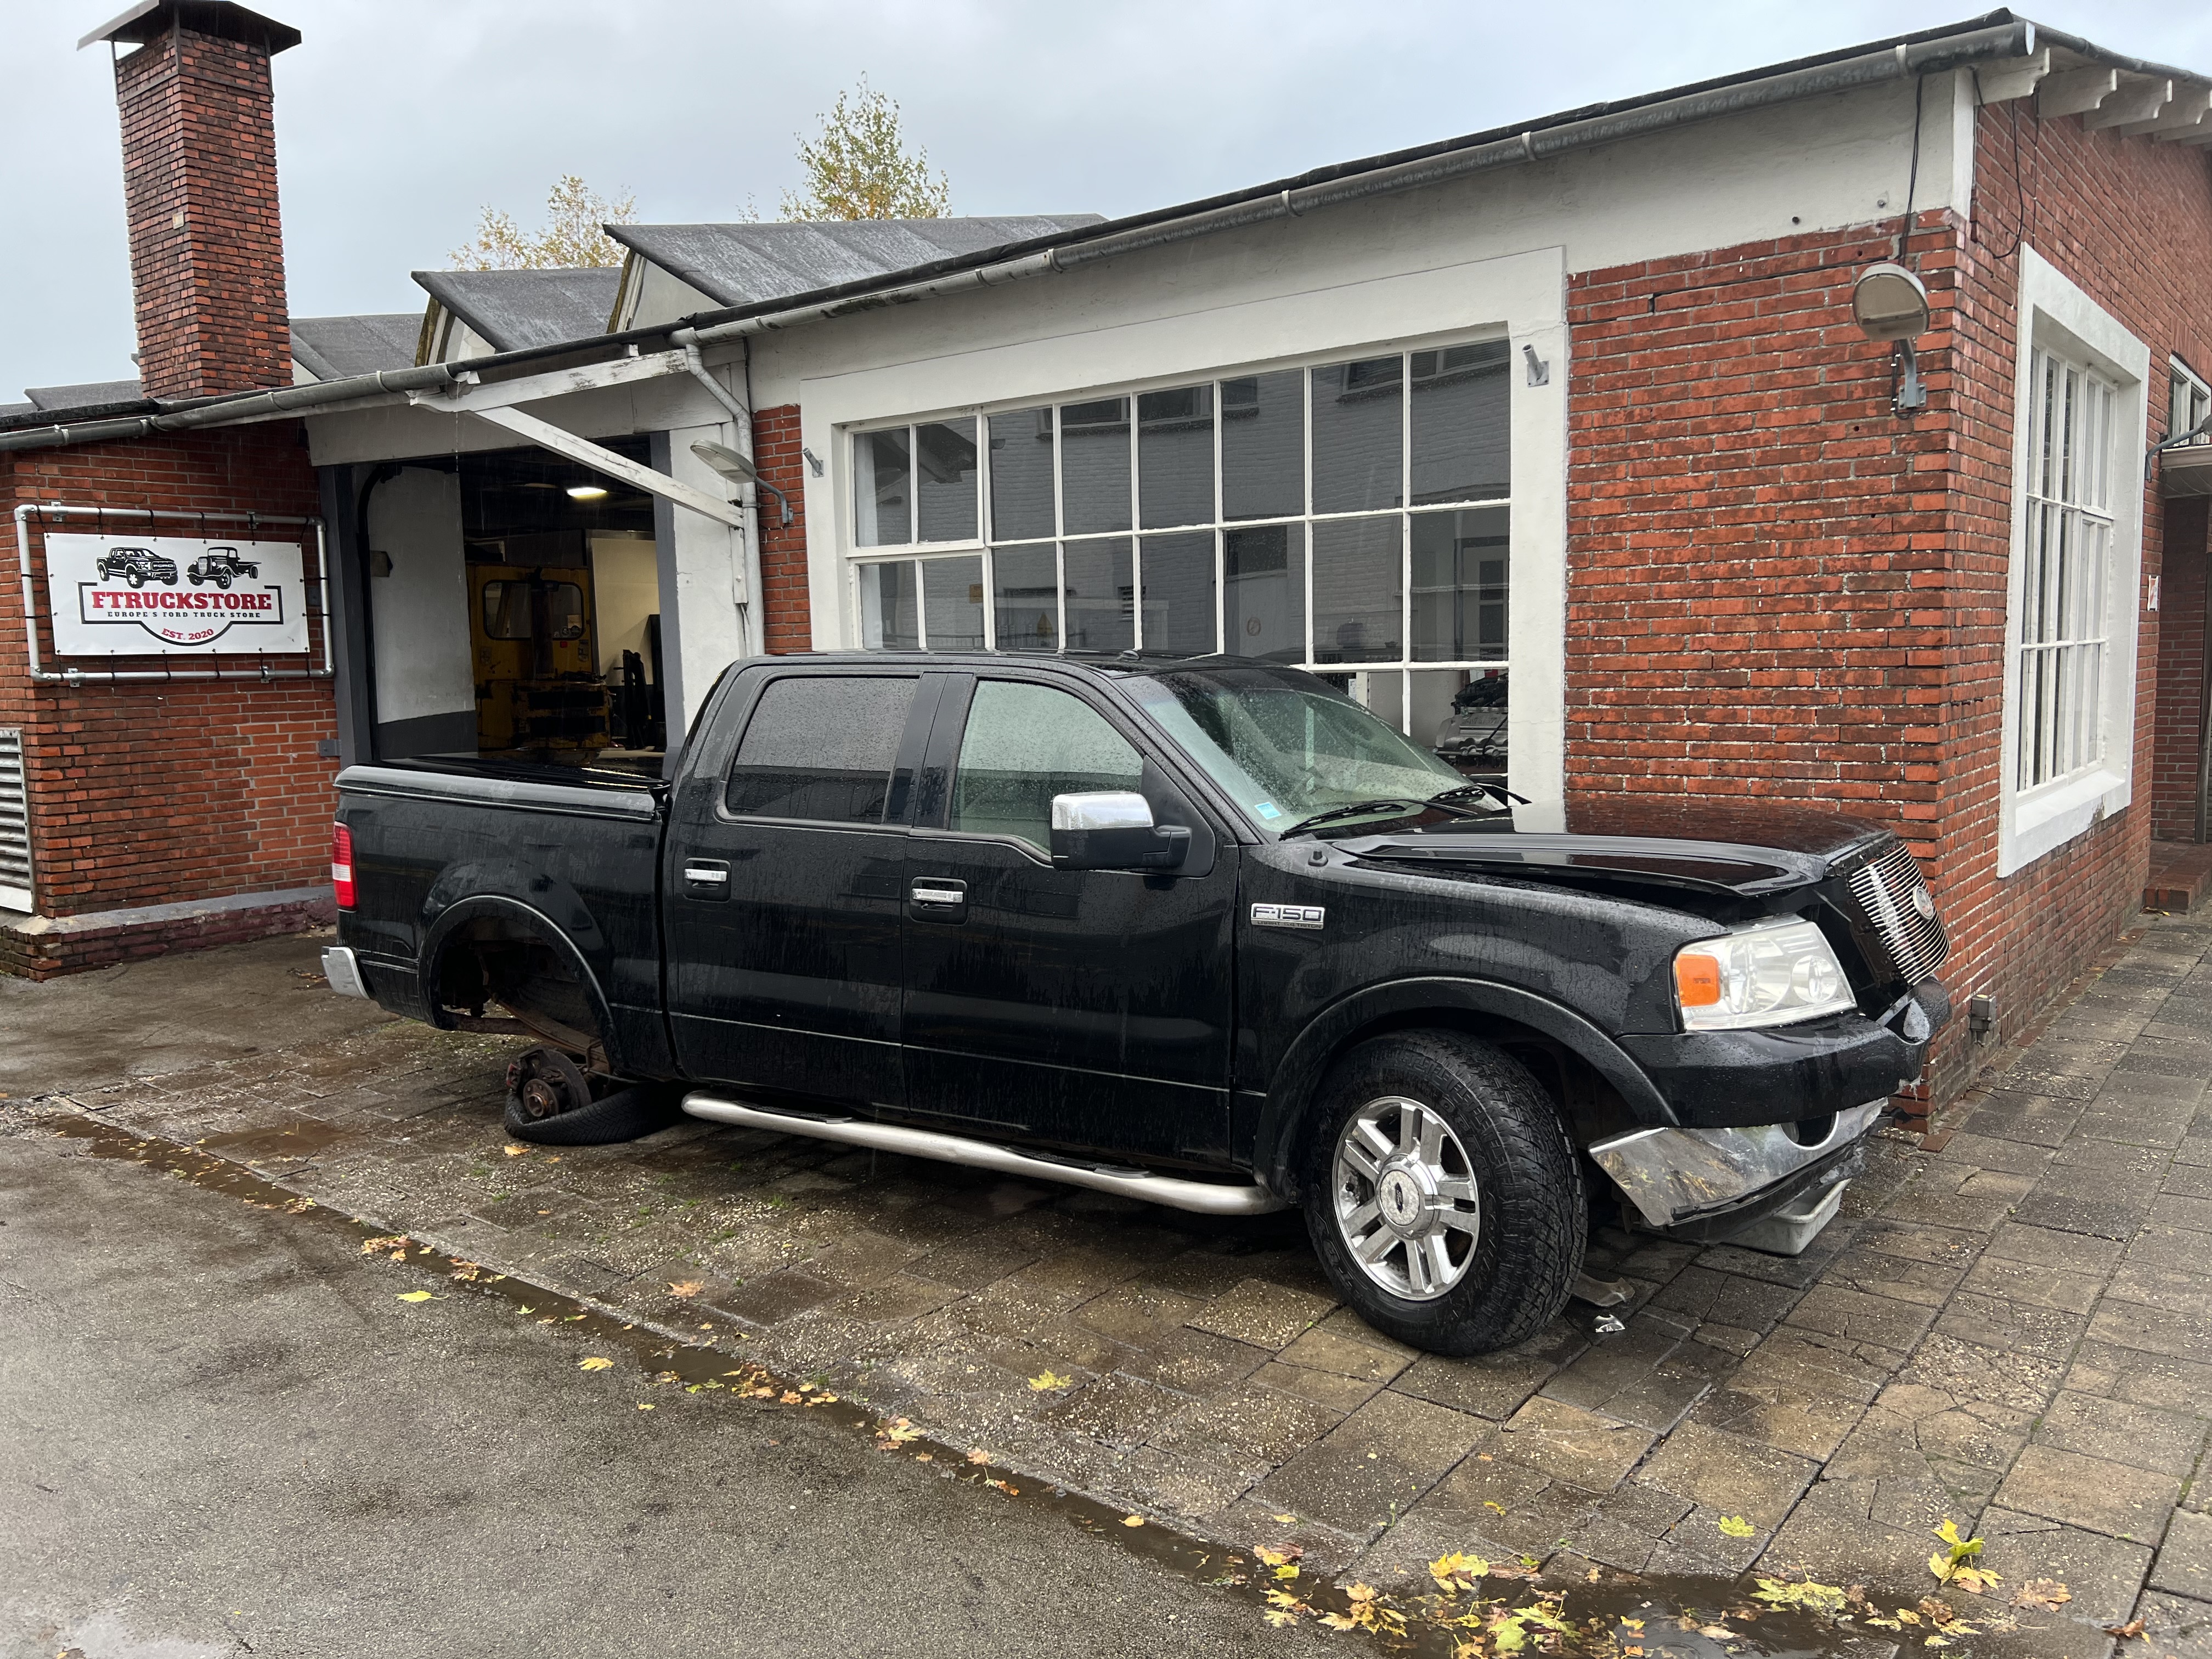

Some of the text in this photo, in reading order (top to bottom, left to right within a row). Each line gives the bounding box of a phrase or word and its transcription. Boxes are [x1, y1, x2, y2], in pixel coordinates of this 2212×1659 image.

[92, 591, 272, 610] FTRUCKSTORE
[188, 629, 214, 640] 2020
[1252, 906, 1322, 922] F-150
